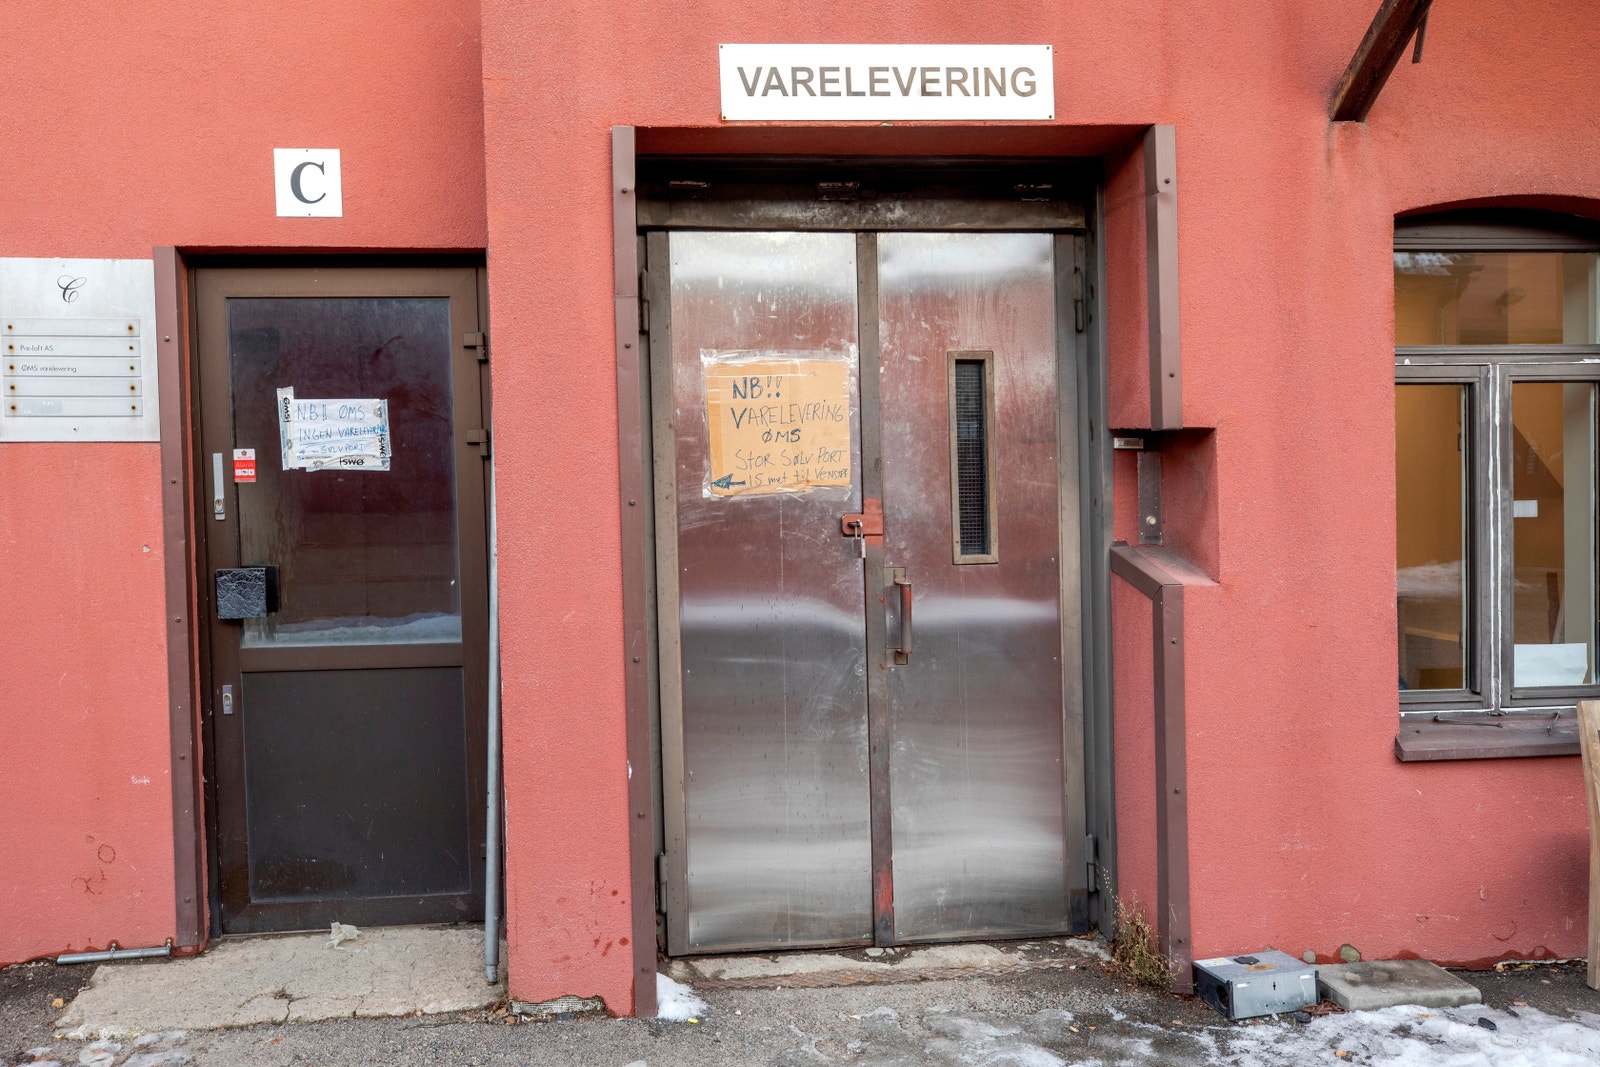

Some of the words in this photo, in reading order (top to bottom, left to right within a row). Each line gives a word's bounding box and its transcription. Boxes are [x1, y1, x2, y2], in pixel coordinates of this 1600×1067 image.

[736, 66, 1037, 97] VARELEVERING
[290, 161, 326, 204] C
[39, 365, 77, 373] varelevering
[732, 376, 783, 399] NB!!
[296, 403, 328, 422] NB!!
[338, 404, 366, 421] ØMS
[730, 400, 844, 429] VARELEVERING
[298, 427, 333, 442] INGEN
[761, 428, 802, 443] ØMS
[818, 446, 848, 464] PORT
[793, 469, 810, 481] til
